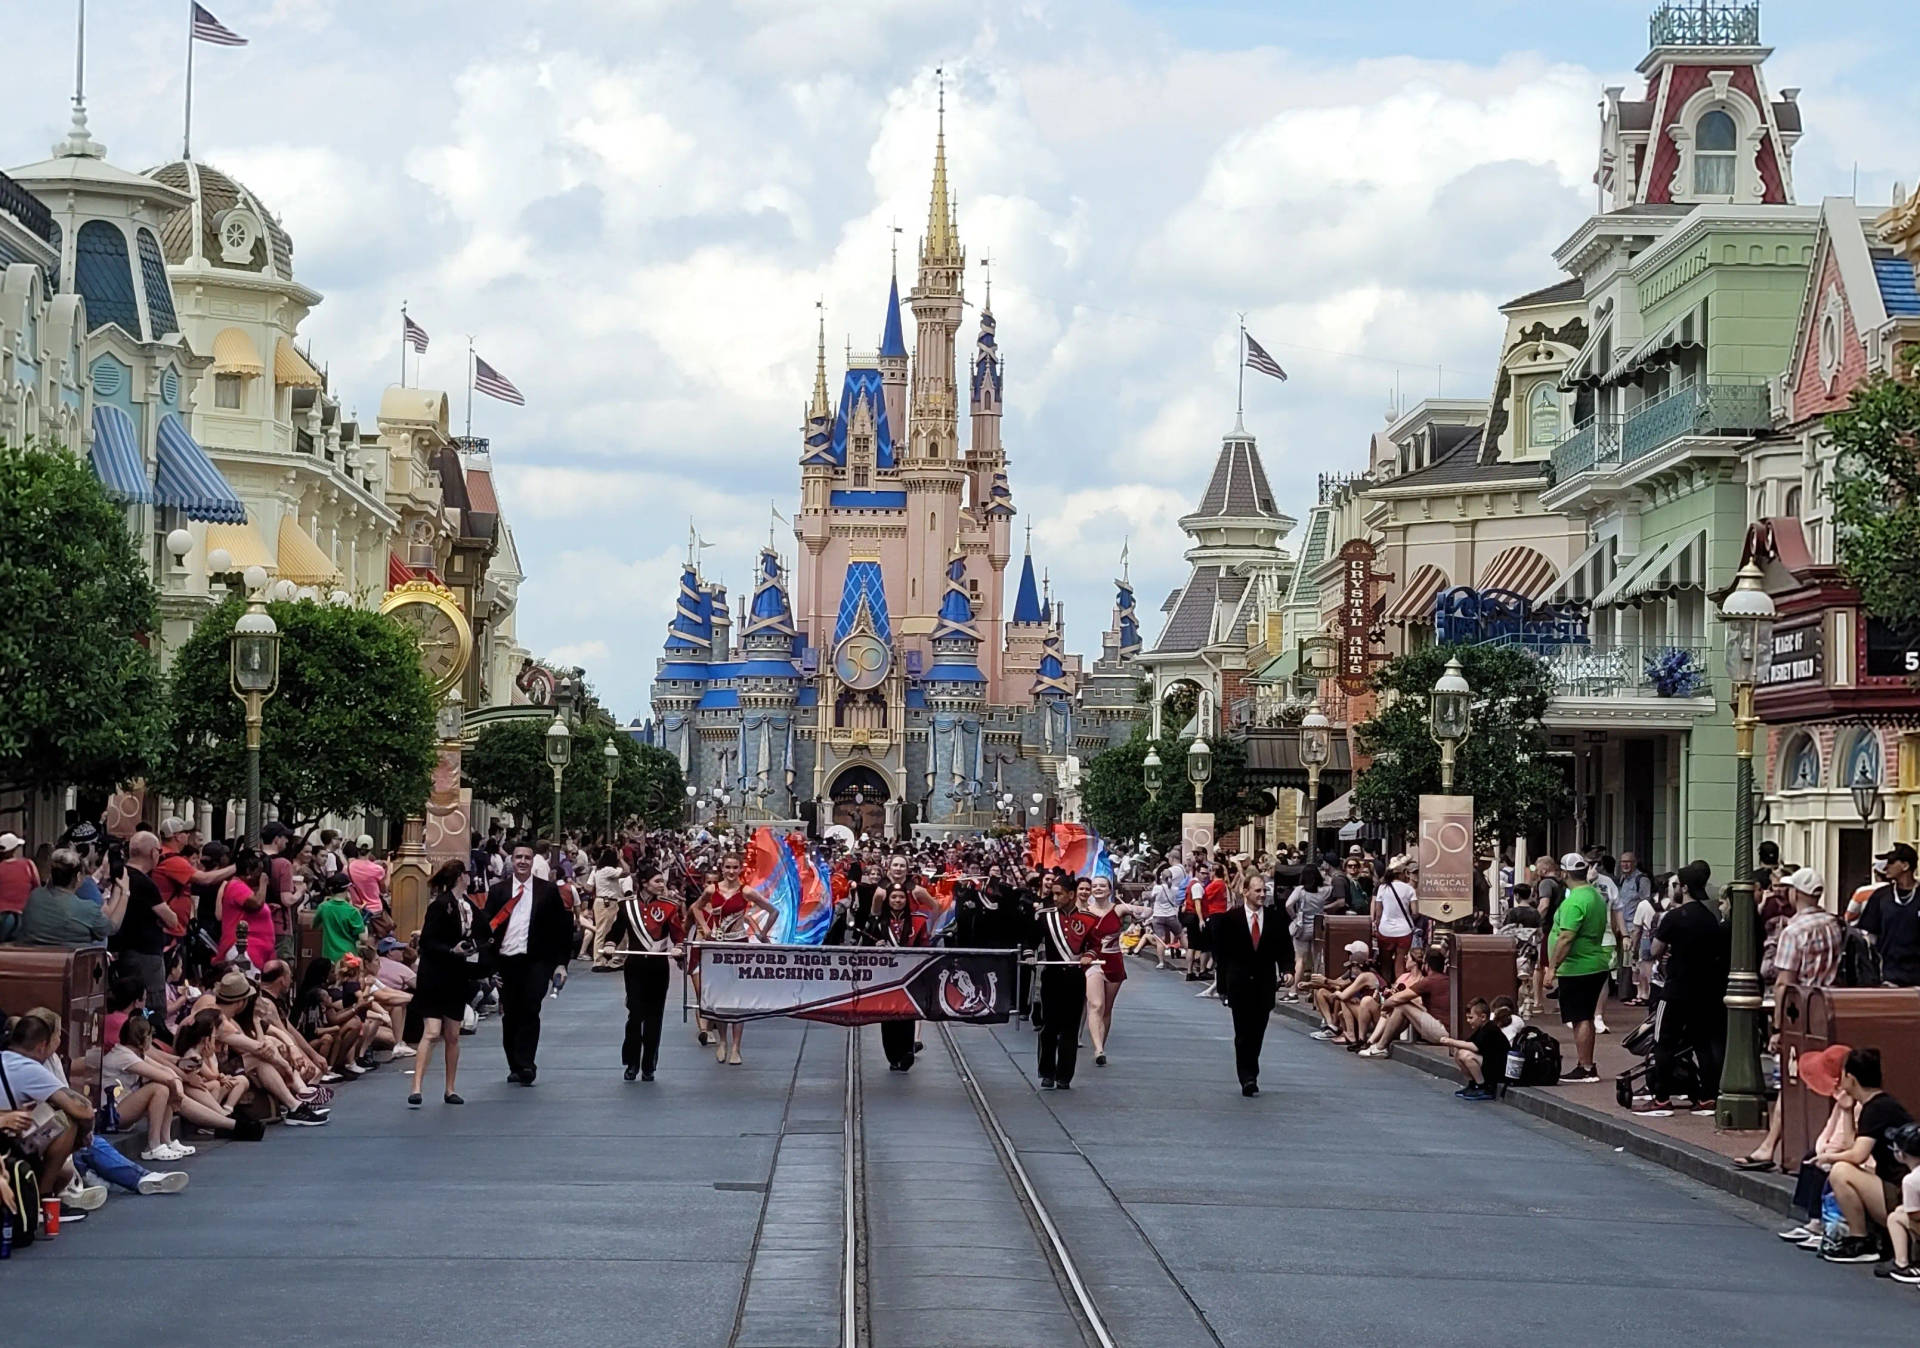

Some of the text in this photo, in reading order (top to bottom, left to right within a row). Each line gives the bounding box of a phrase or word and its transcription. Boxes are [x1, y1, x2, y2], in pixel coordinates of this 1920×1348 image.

[1349, 560, 1365, 674] CRYSTAL ARTS
[847, 644, 883, 682] 50
[1423, 819, 1469, 868] 50
[1425, 879, 1467, 887] MAGICAL
[712, 953, 899, 968] BEDFORD HIGH SCHOOL
[738, 966, 873, 982] MARCHING BAND
